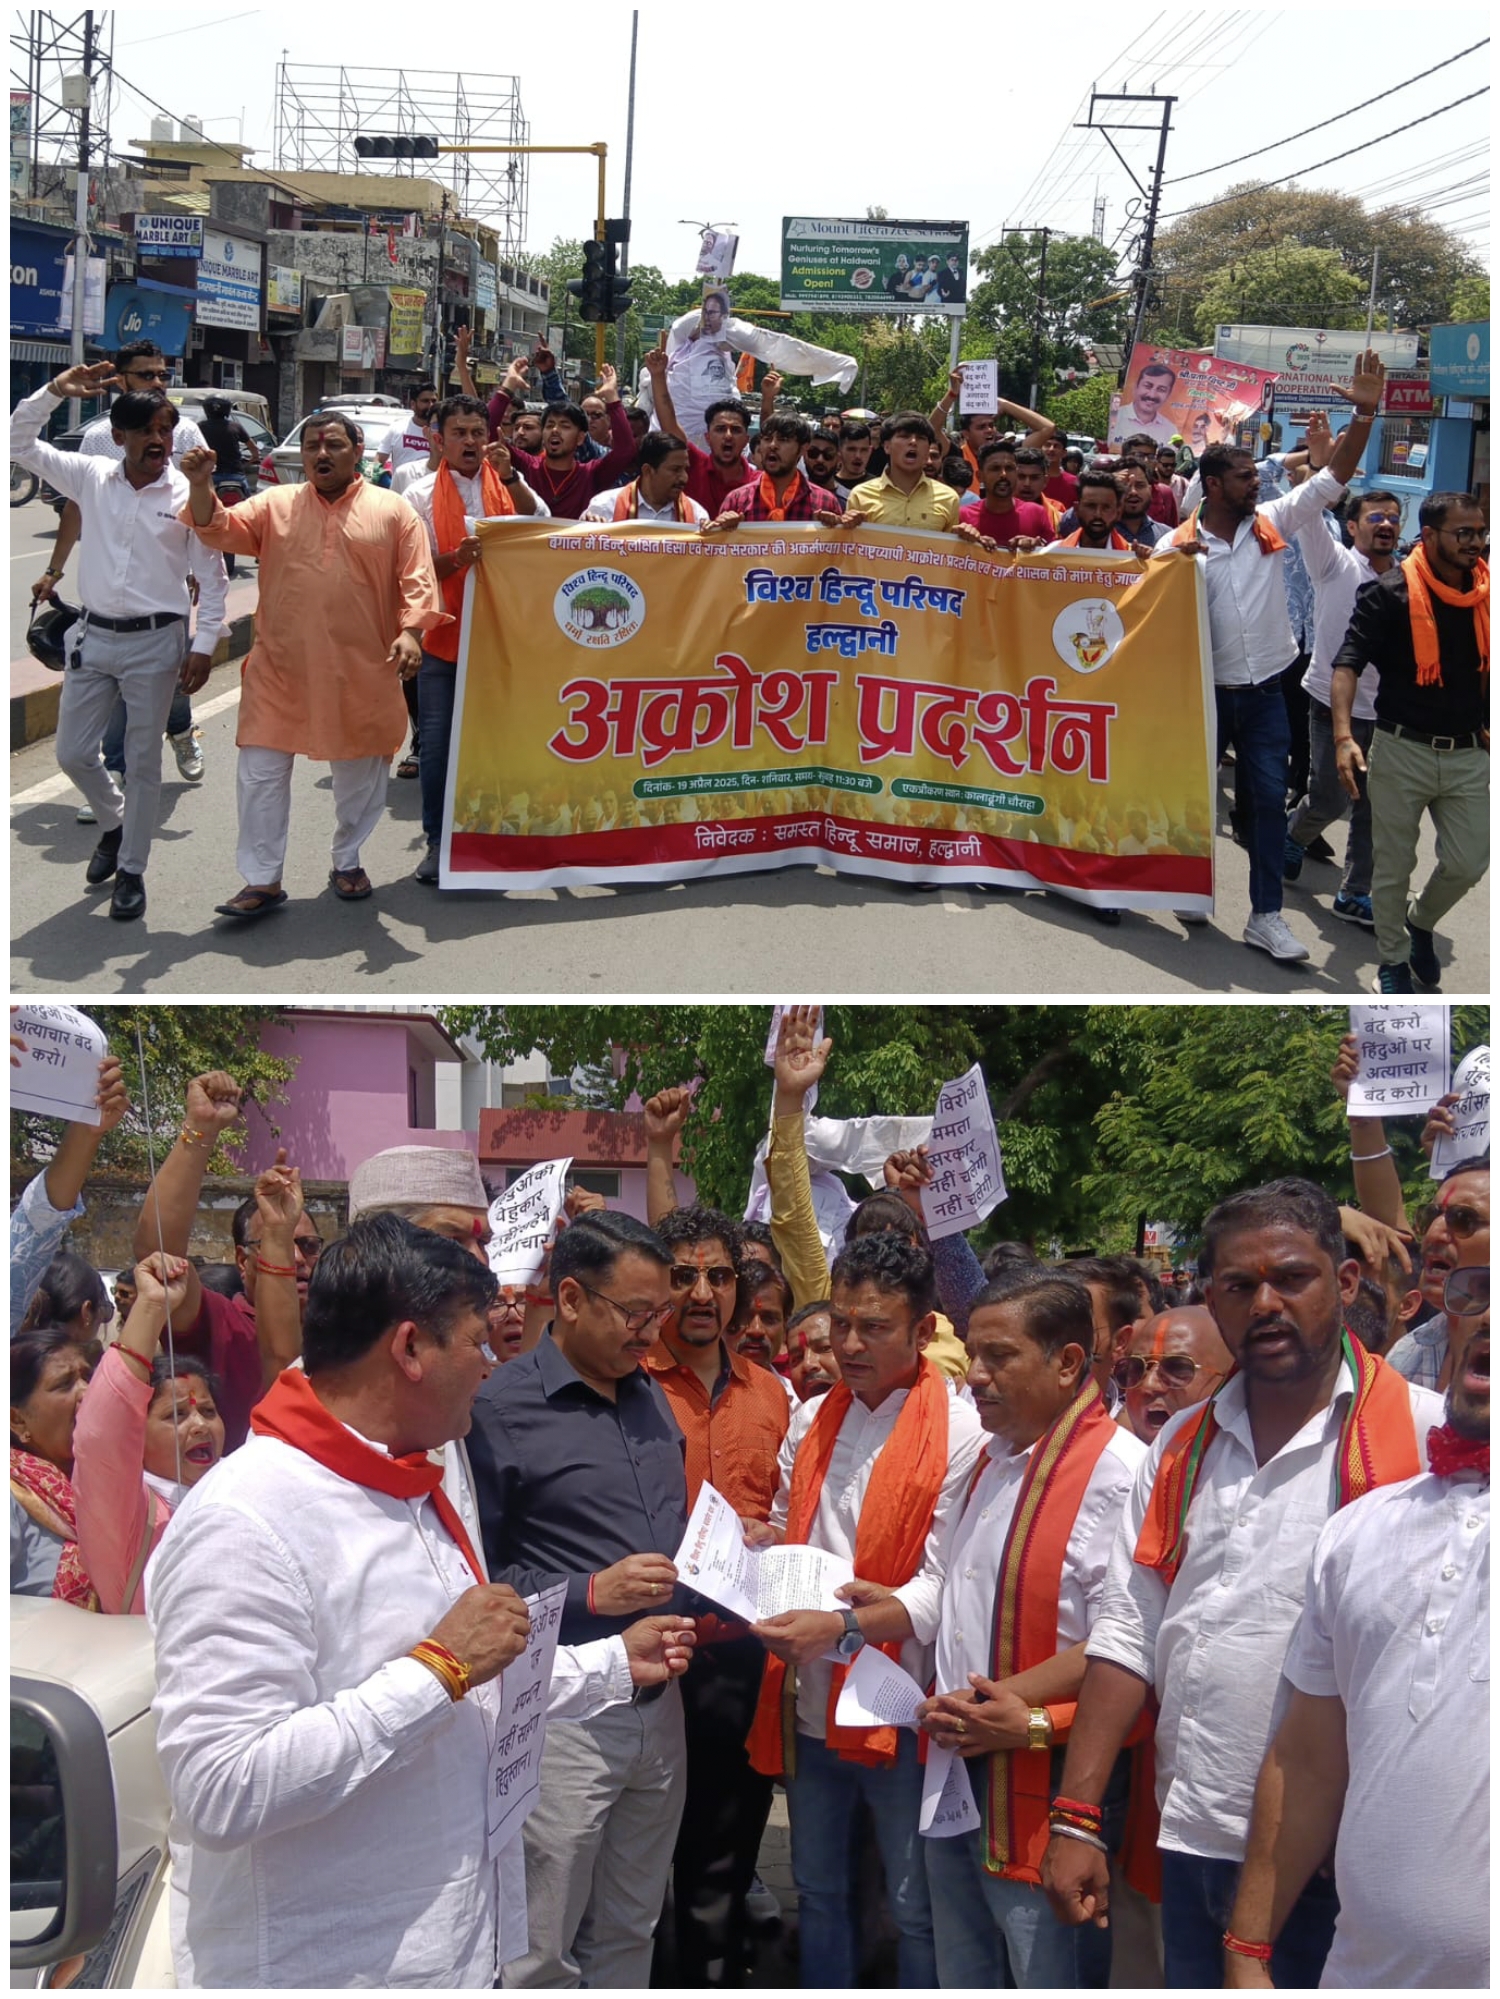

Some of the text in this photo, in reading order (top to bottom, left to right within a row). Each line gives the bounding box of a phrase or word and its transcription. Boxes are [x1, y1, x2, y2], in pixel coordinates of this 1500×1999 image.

[151, 217, 200, 231] UNIQUE
[811, 222, 849, 235] Mount
[135, 230, 190, 243] MARBLE ART
[788, 255, 828, 264] Geniuses
[840, 256, 881, 266] Haldwani
[790, 244, 880, 255] Nurturing Tomorrow's
[791, 266, 846, 276] Admissions
[803, 278, 834, 289] Open!
[123, 311, 142, 332] Jio
[1390, 389, 1430, 403] ATM
[585, 533, 597, 550] में
[599, 534, 628, 557] हिन्दू
[704, 544, 728, 556] राज्य
[729, 543, 769, 556] सरकार
[771, 539, 787, 555] की
[842, 543, 856, 555] पर
[906, 549, 945, 566] आक्रोश
[1016, 566, 1050, 581] शासन
[1052, 566, 1068, 582] की
[1069, 567, 1093, 583] मांग
[1094, 568, 1113, 588] हेतु
[561, 569, 639, 599] विश्व हिन्दू परिषद
[744, 566, 967, 618] विश्व हिन्दू परिषद
[805, 620, 898, 657] हल्द्वानी
[547, 652, 1118, 784] अक्रोश प्रदर्शन
[678, 781, 687, 791] 19
[688, 777, 713, 791] अप्रैल
[714, 777, 740, 789] 2025,
[835, 774, 855, 787] 11:30
[857, 776, 873, 789] बजे
[694, 825, 756, 850] निवेदक
[774, 820, 823, 840] समस्त
[824, 818, 863, 853] हिन्दू
[866, 830, 922, 858] समाज,
[928, 834, 982, 860] हल्द्वानी
[13, 1019, 71, 1045] अत्याचार
[1364, 1012, 1422, 1034] बंद करो
[1361, 1037, 1433, 1061] हिंदुओं पर
[1366, 1061, 1429, 1079] अत्याचार
[940, 1079, 979, 1114] विरोधी
[1364, 1084, 1387, 1103] बंद
[932, 1116, 971, 1141] ममता
[928, 1138, 976, 1169] सरकार
[929, 1152, 988, 1194] नहीं चलेगी
[933, 1174, 993, 1217] नहीं चलेगी
